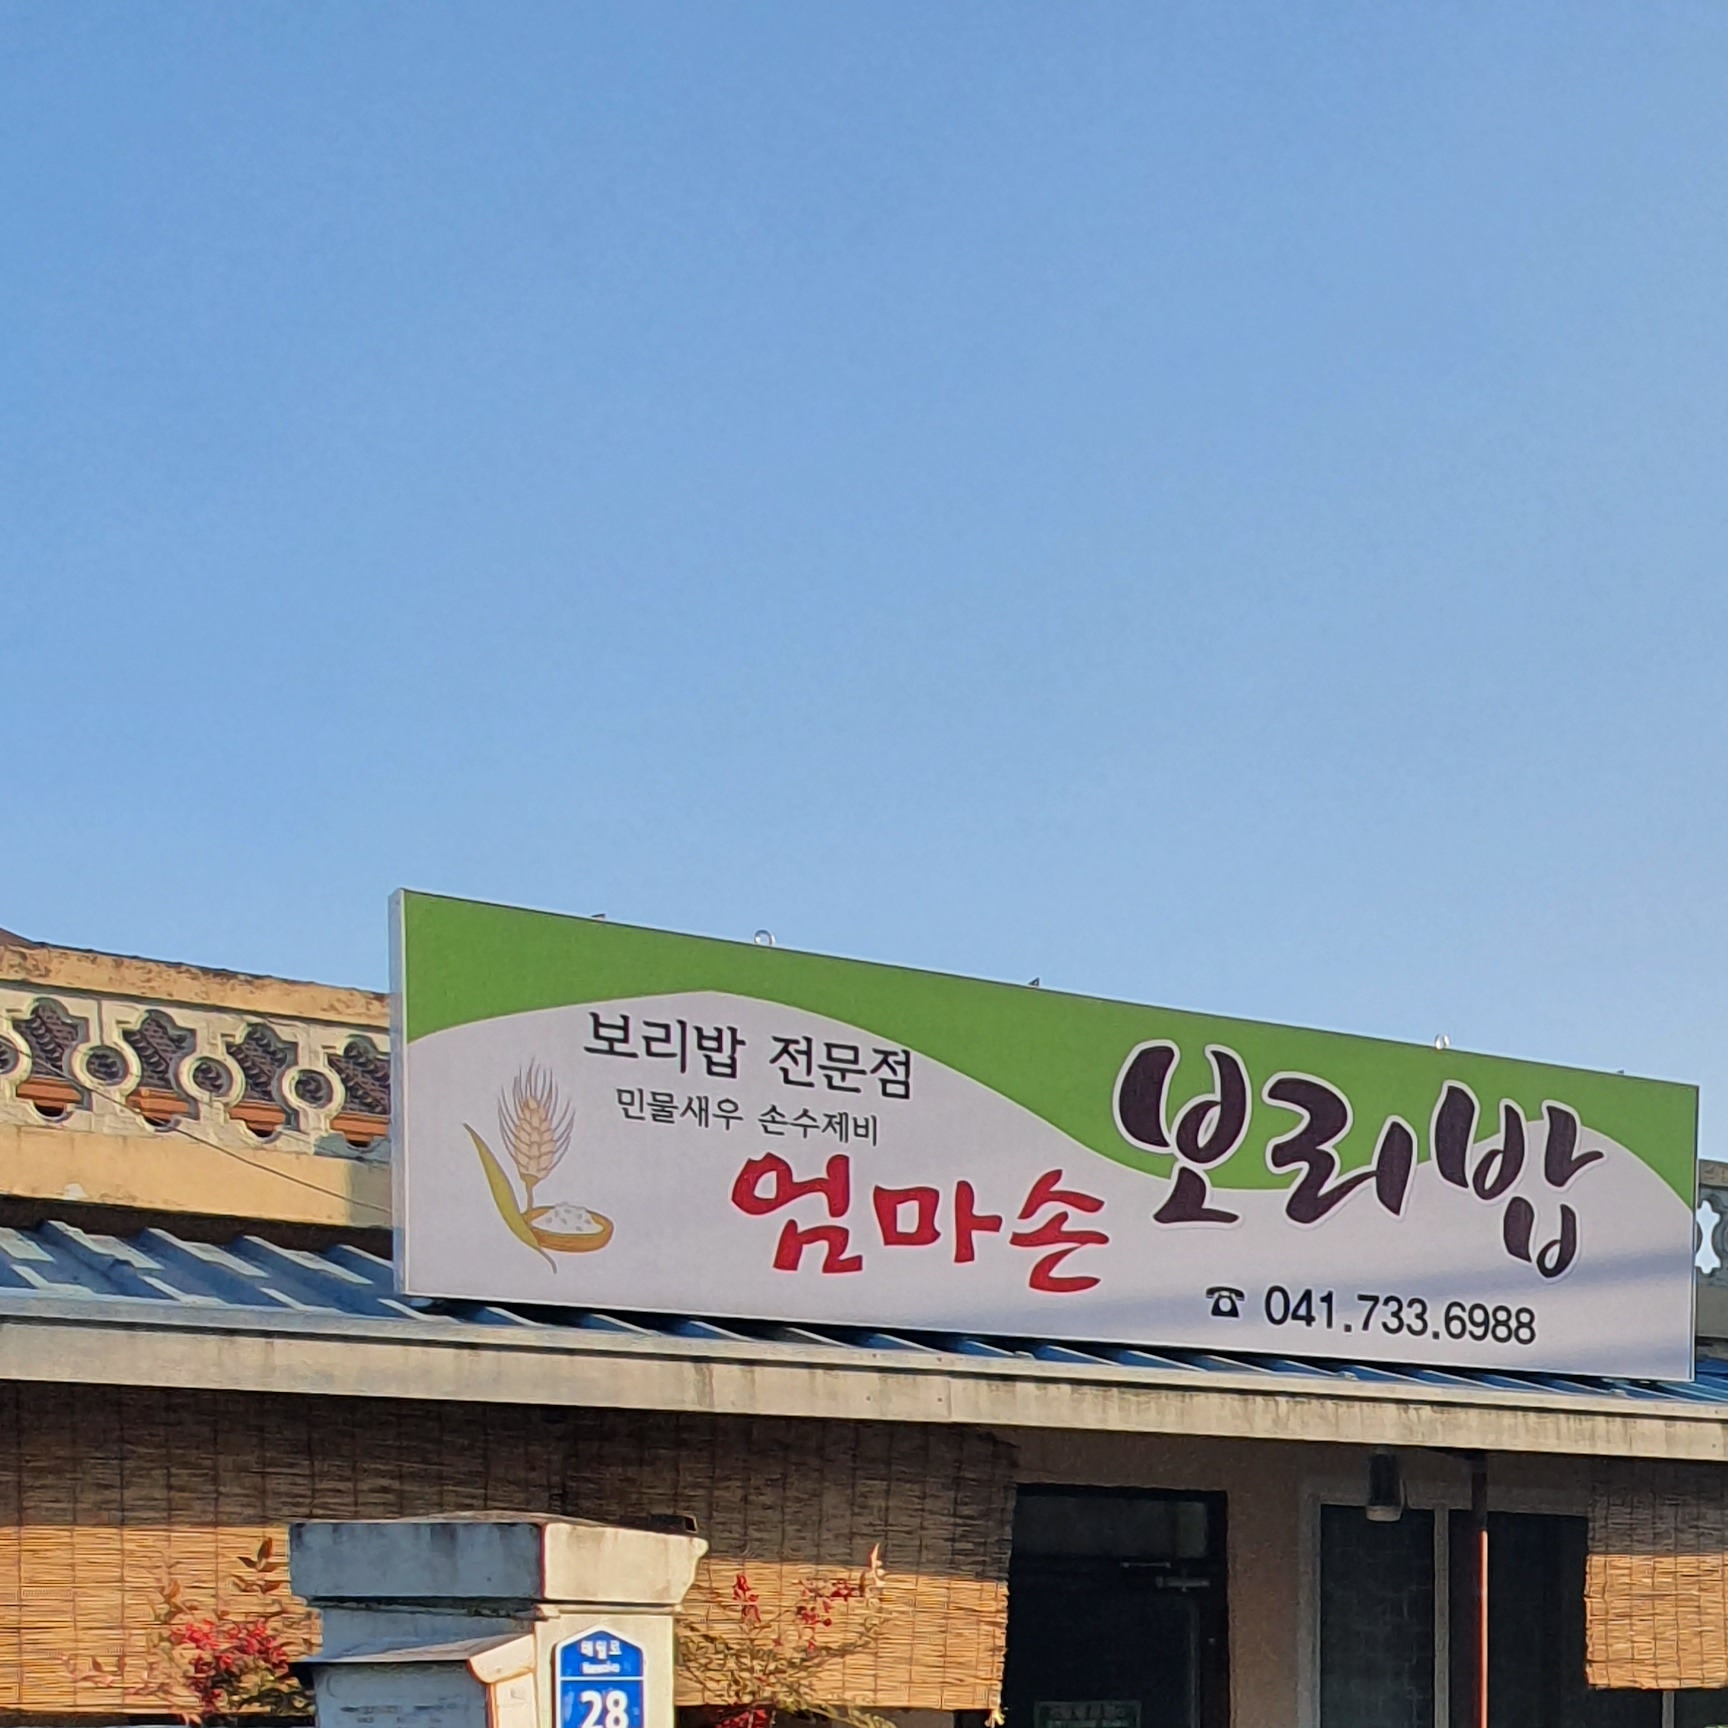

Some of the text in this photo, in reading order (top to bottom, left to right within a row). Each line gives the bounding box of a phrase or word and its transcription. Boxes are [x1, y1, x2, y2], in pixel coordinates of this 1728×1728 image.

[583, 1011, 914, 1099] 보리밥 전문점
[615, 1086, 880, 1146] 민물새우 손수제비
[730, 1043, 1606, 1293] 엄마손 보리밥
[1264, 1285, 1537, 1345] 041.733.6988
